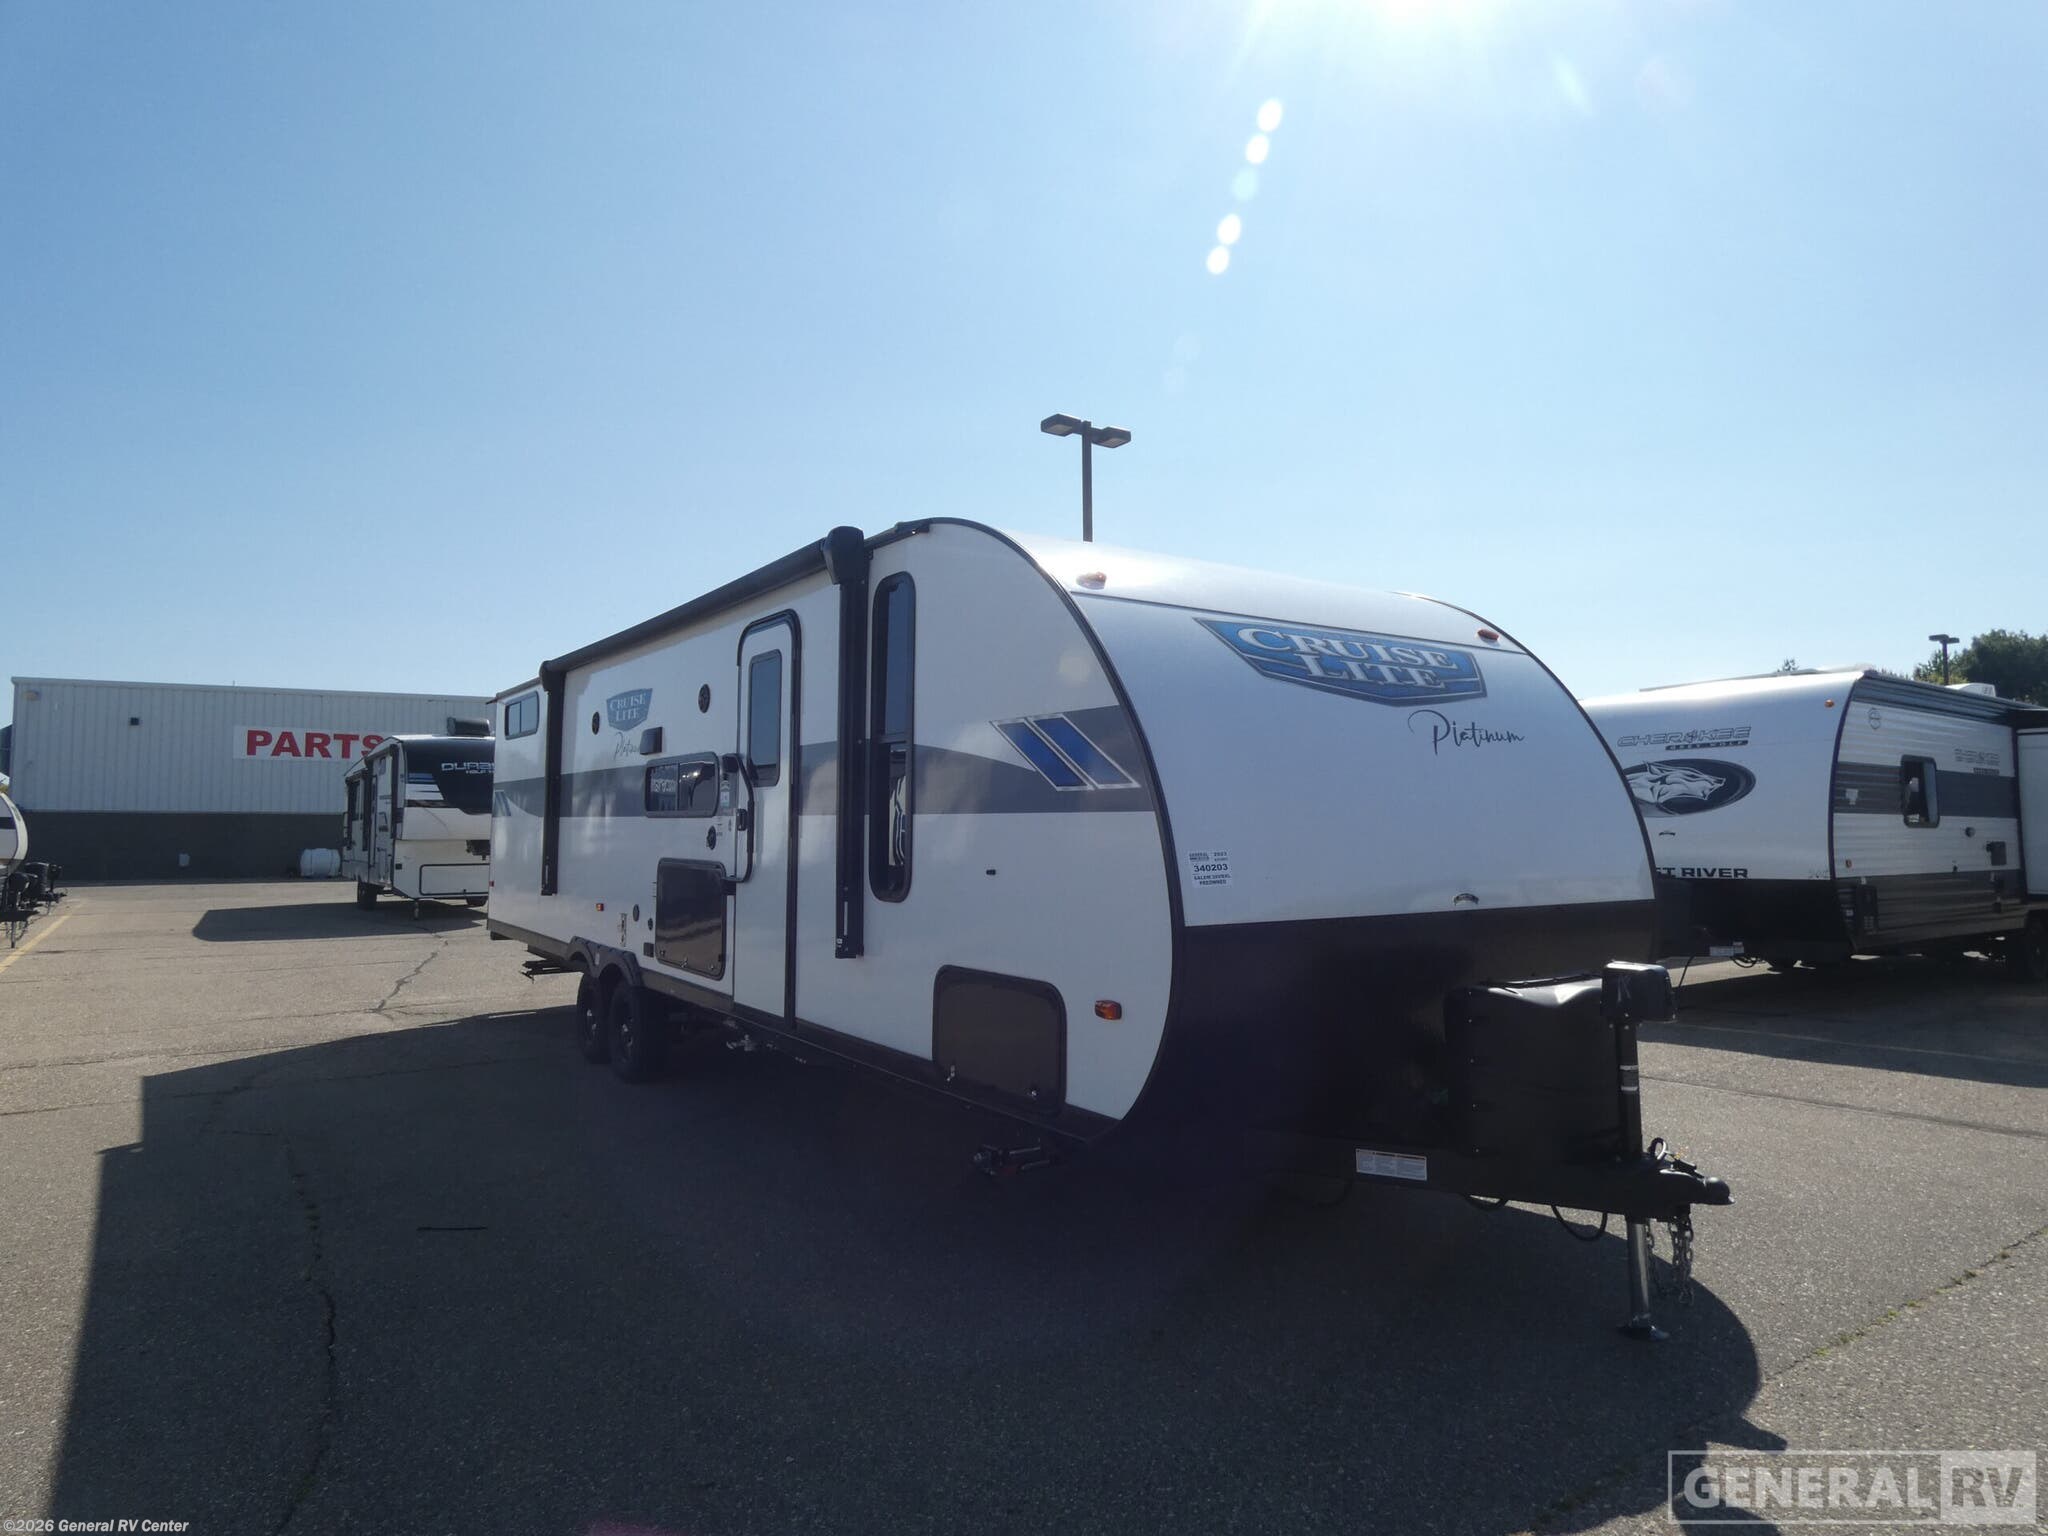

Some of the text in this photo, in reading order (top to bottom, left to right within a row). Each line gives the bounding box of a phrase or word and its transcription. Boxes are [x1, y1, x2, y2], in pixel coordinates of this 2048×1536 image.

[1238, 628, 1457, 670] CRUISE
[1294, 653, 1445, 688] LITE
[609, 692, 647, 711] CRUISE
[615, 706, 640, 721] LITE
[1407, 709, 1525, 755] Platinum
[246, 730, 386, 759] PARTS
[1193, 863, 1228, 872] 340203
[1681, 867, 1749, 878] RIVER
